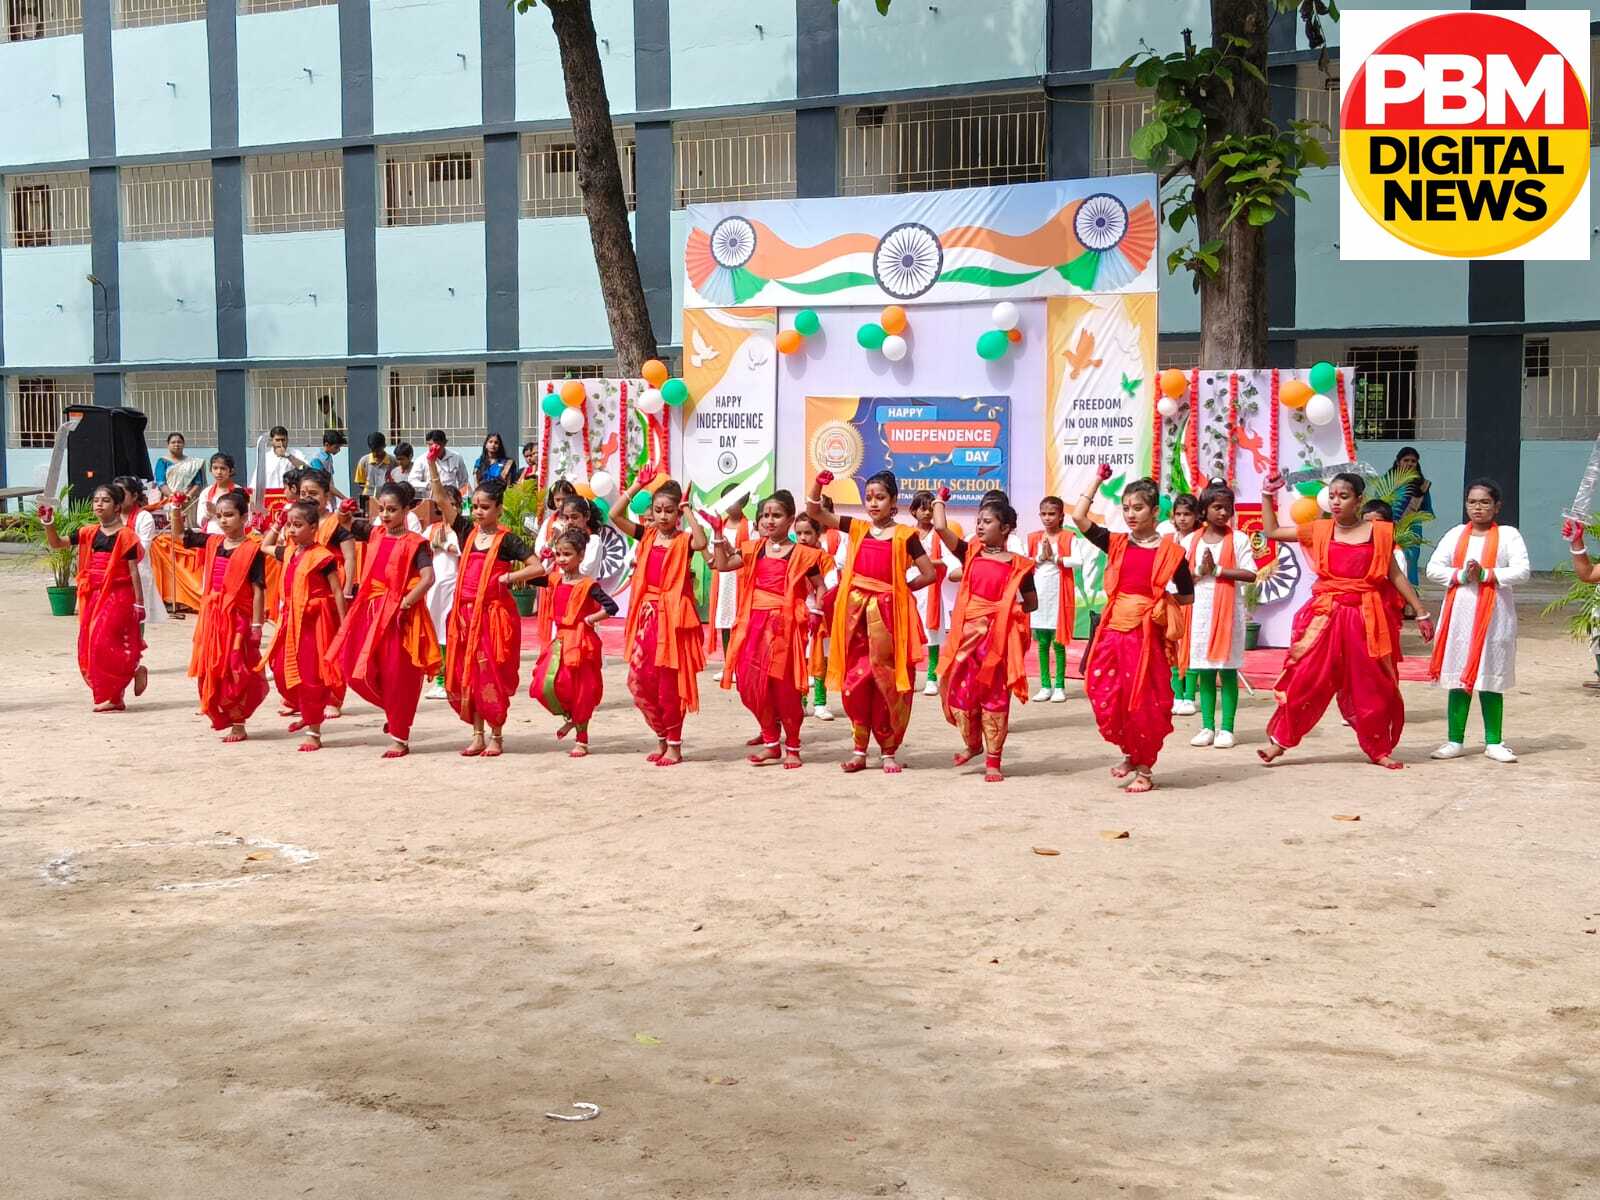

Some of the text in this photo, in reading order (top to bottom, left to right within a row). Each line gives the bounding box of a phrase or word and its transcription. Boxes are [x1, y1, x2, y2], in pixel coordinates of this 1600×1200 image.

[715, 395, 743, 408] HAPPY
[1073, 398, 1121, 410] FREEDOM
[888, 407, 924, 418] HAPPY
[696, 412, 764, 429] INDEPENDENCE
[1065, 416, 1133, 429] IN OUR MINDS
[719, 435, 737, 448] DAY
[891, 428, 992, 442] INDEPENDENCE
[1083, 435, 1113, 447] PRIDE
[965, 450, 990, 463] DAY
[1064, 453, 1134, 465] IN OUR HEARTS
[950, 479, 1003, 491] SCHOOL
